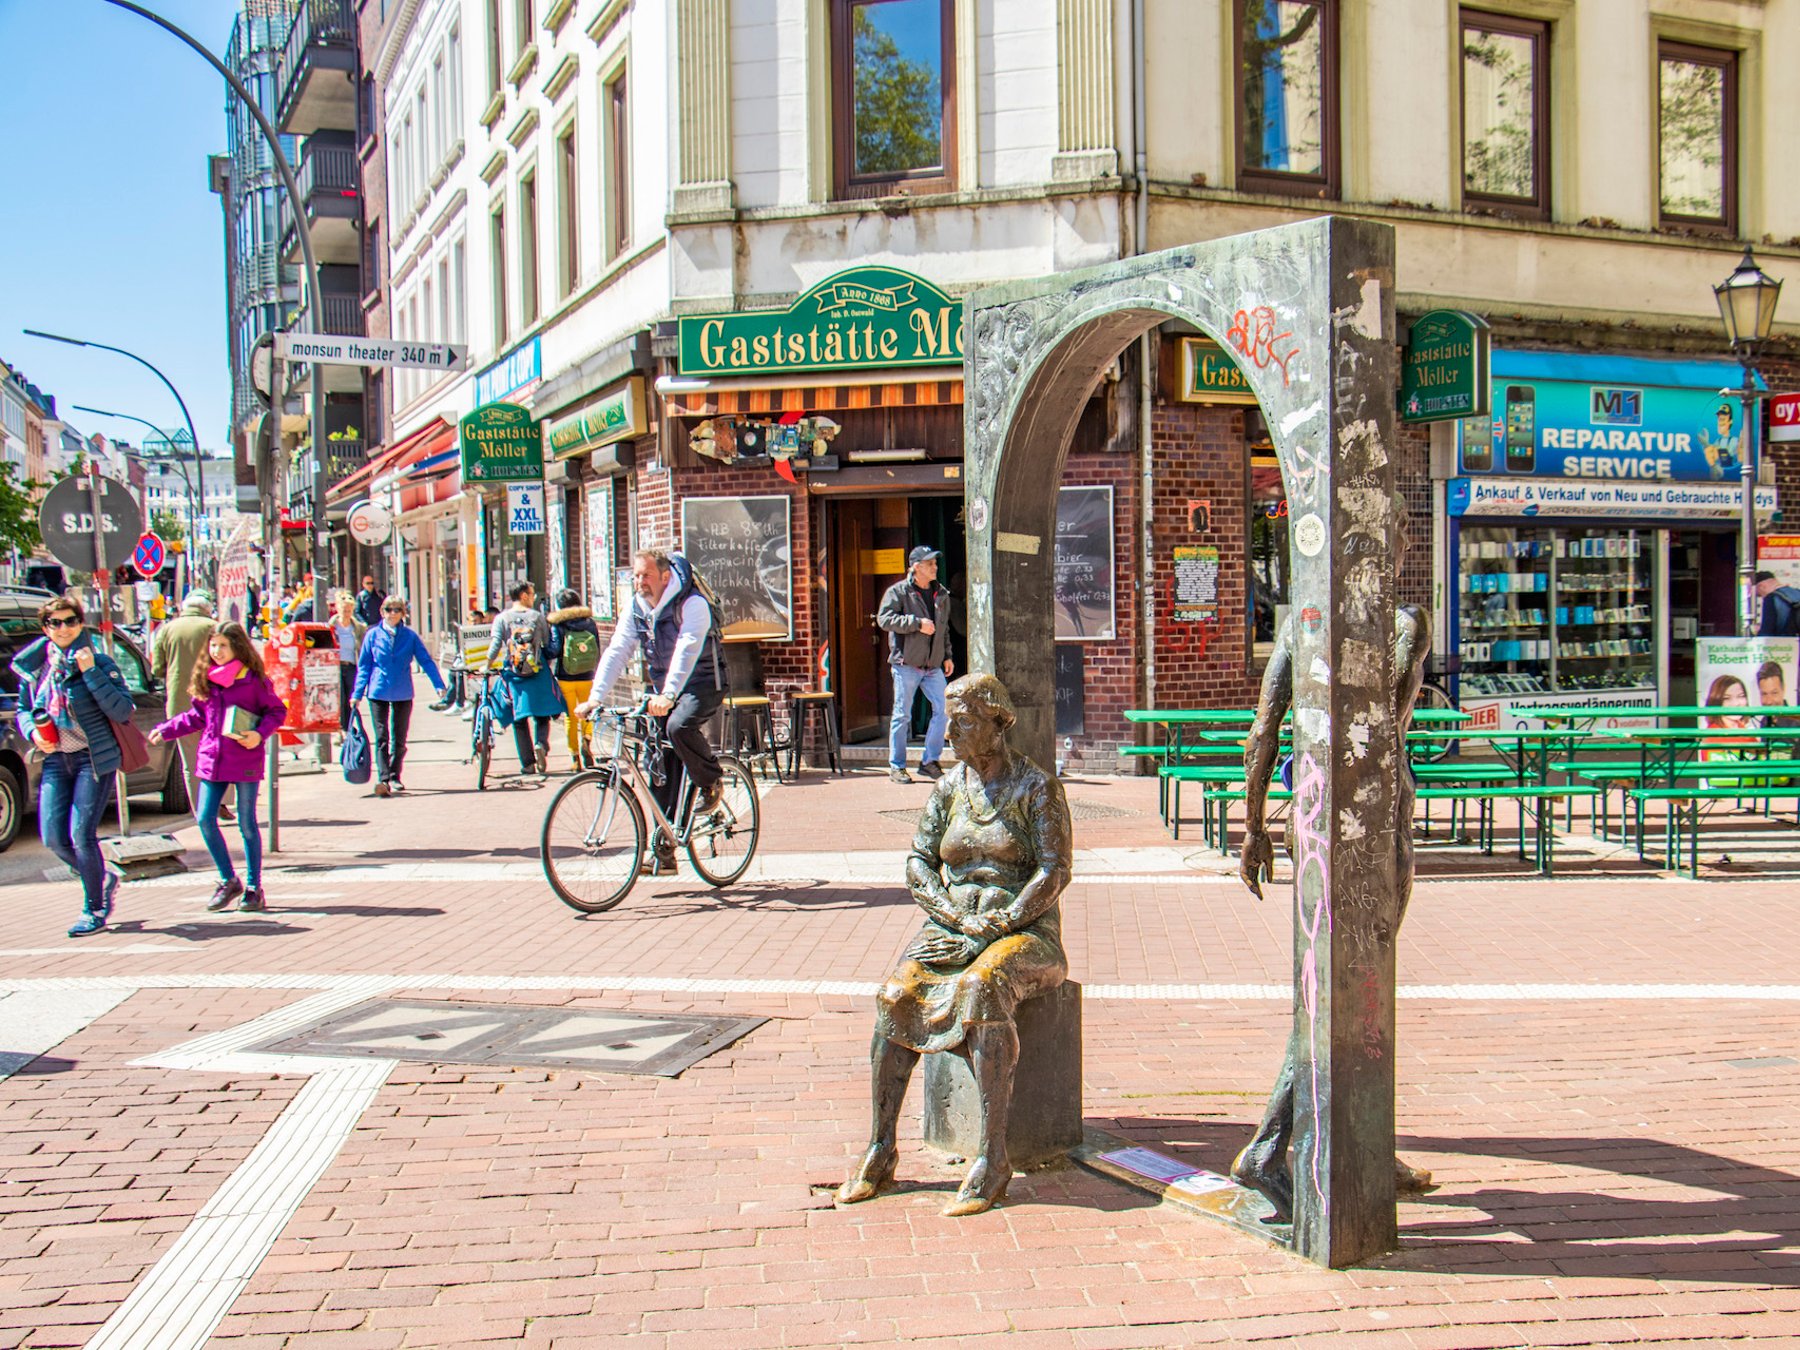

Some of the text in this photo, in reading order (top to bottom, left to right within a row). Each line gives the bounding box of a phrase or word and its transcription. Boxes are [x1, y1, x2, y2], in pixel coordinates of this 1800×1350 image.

[841, 286, 866, 300] Anno
[700, 319, 899, 368] Gaststätte
[292, 343, 441, 364] monsun theater 340 m
[1416, 365, 1459, 388] Möller
[1593, 391, 1640, 415] M1
[465, 423, 539, 440] Gaststätte
[1541, 427, 1692, 453] REPARATUR
[479, 441, 528, 458] Möller
[1563, 456, 1672, 478] SERVICE
[521, 493, 530, 505] &
[1475, 484, 1521, 500] Ankauf
[1525, 486, 1534, 500] &
[1538, 486, 1586, 501] Verkauf
[1590, 490, 1611, 501] von
[1615, 489, 1637, 502] Neu
[1641, 489, 1662, 502] und
[1666, 489, 1731, 504] Gebrauchte
[1734, 491, 1774, 507] Hdys
[513, 508, 539, 521] XXL
[510, 521, 543, 532] PRINT
[698, 537, 769, 555] Filterkaffee
[1708, 654, 1749, 665] Robert
